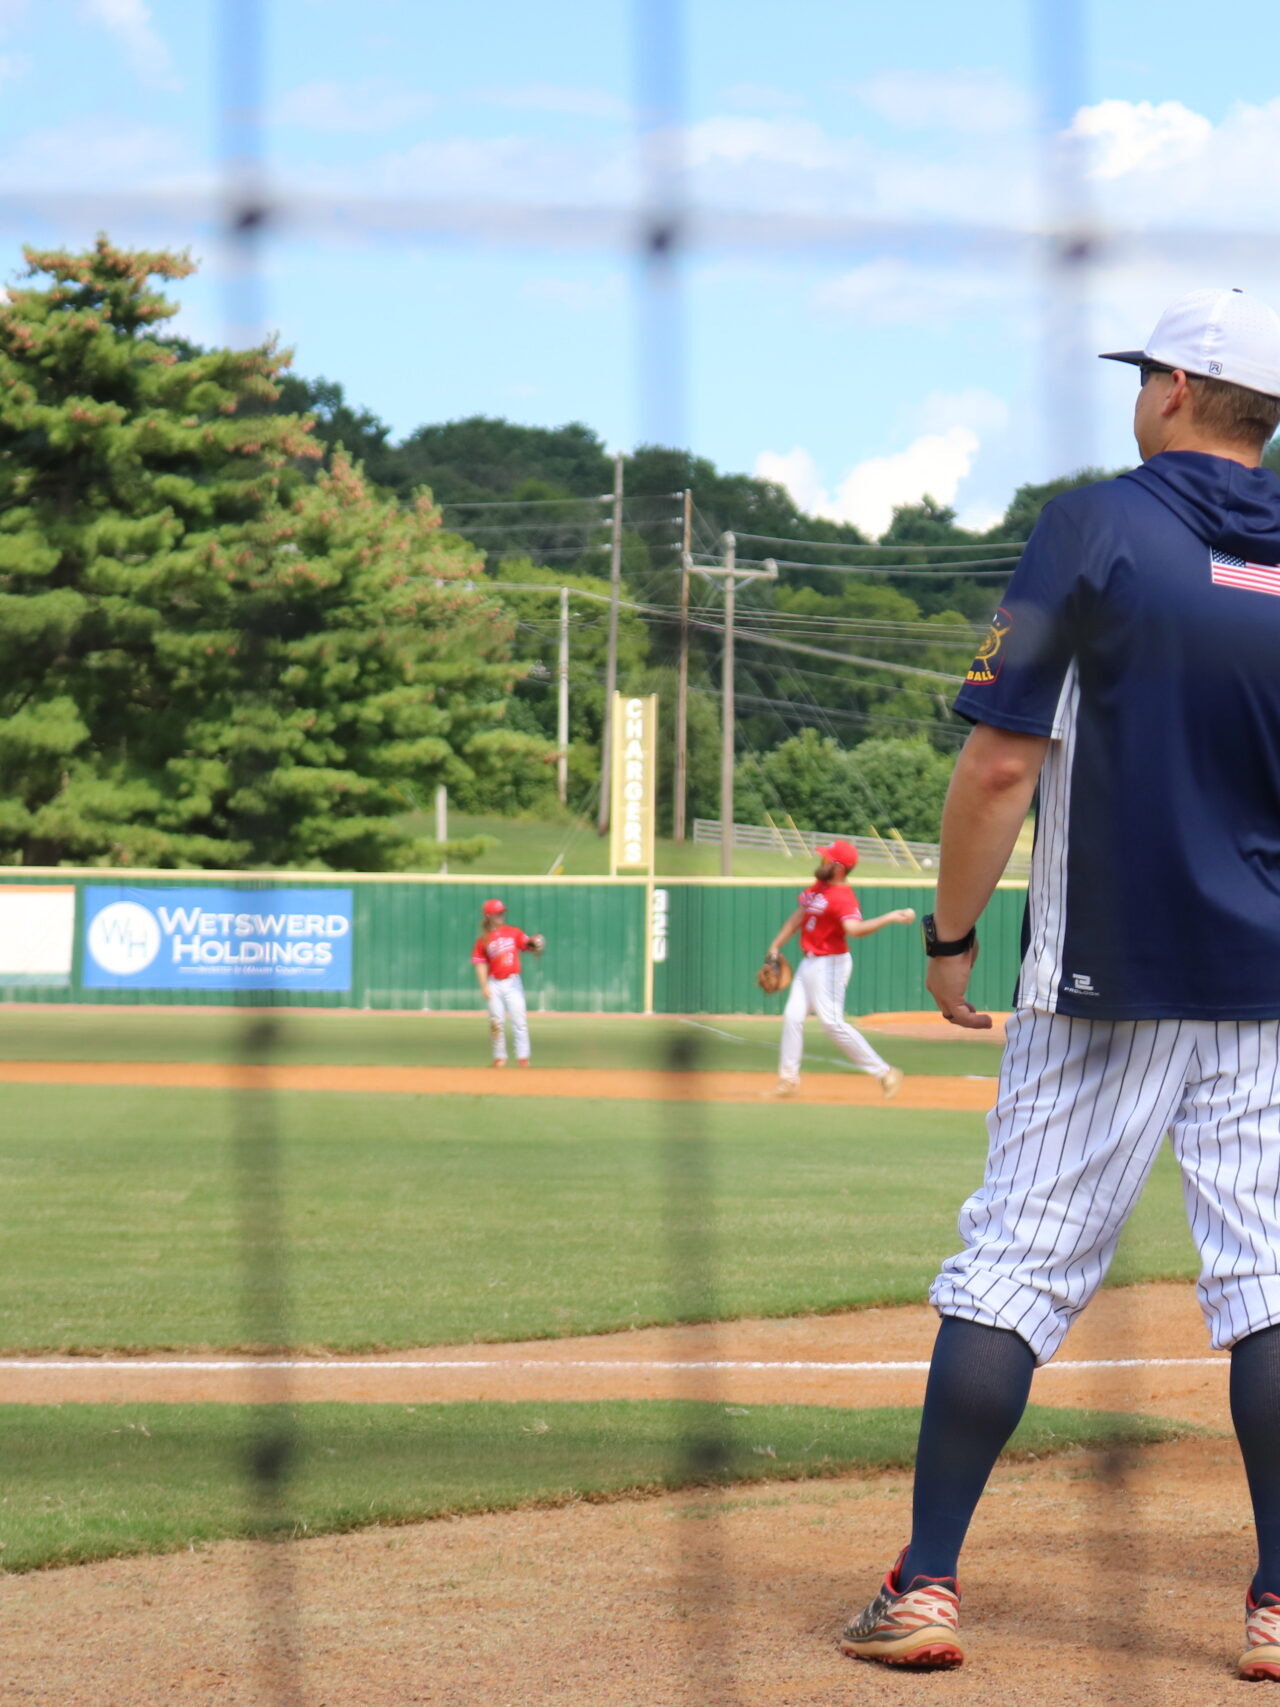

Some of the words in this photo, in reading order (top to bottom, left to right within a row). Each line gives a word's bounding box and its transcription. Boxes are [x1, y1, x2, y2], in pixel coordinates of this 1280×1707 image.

[624, 698, 643, 863] CHARGERS
[157, 906, 349, 937] WETSWERD
[172, 935, 333, 964] HOLDINGS
